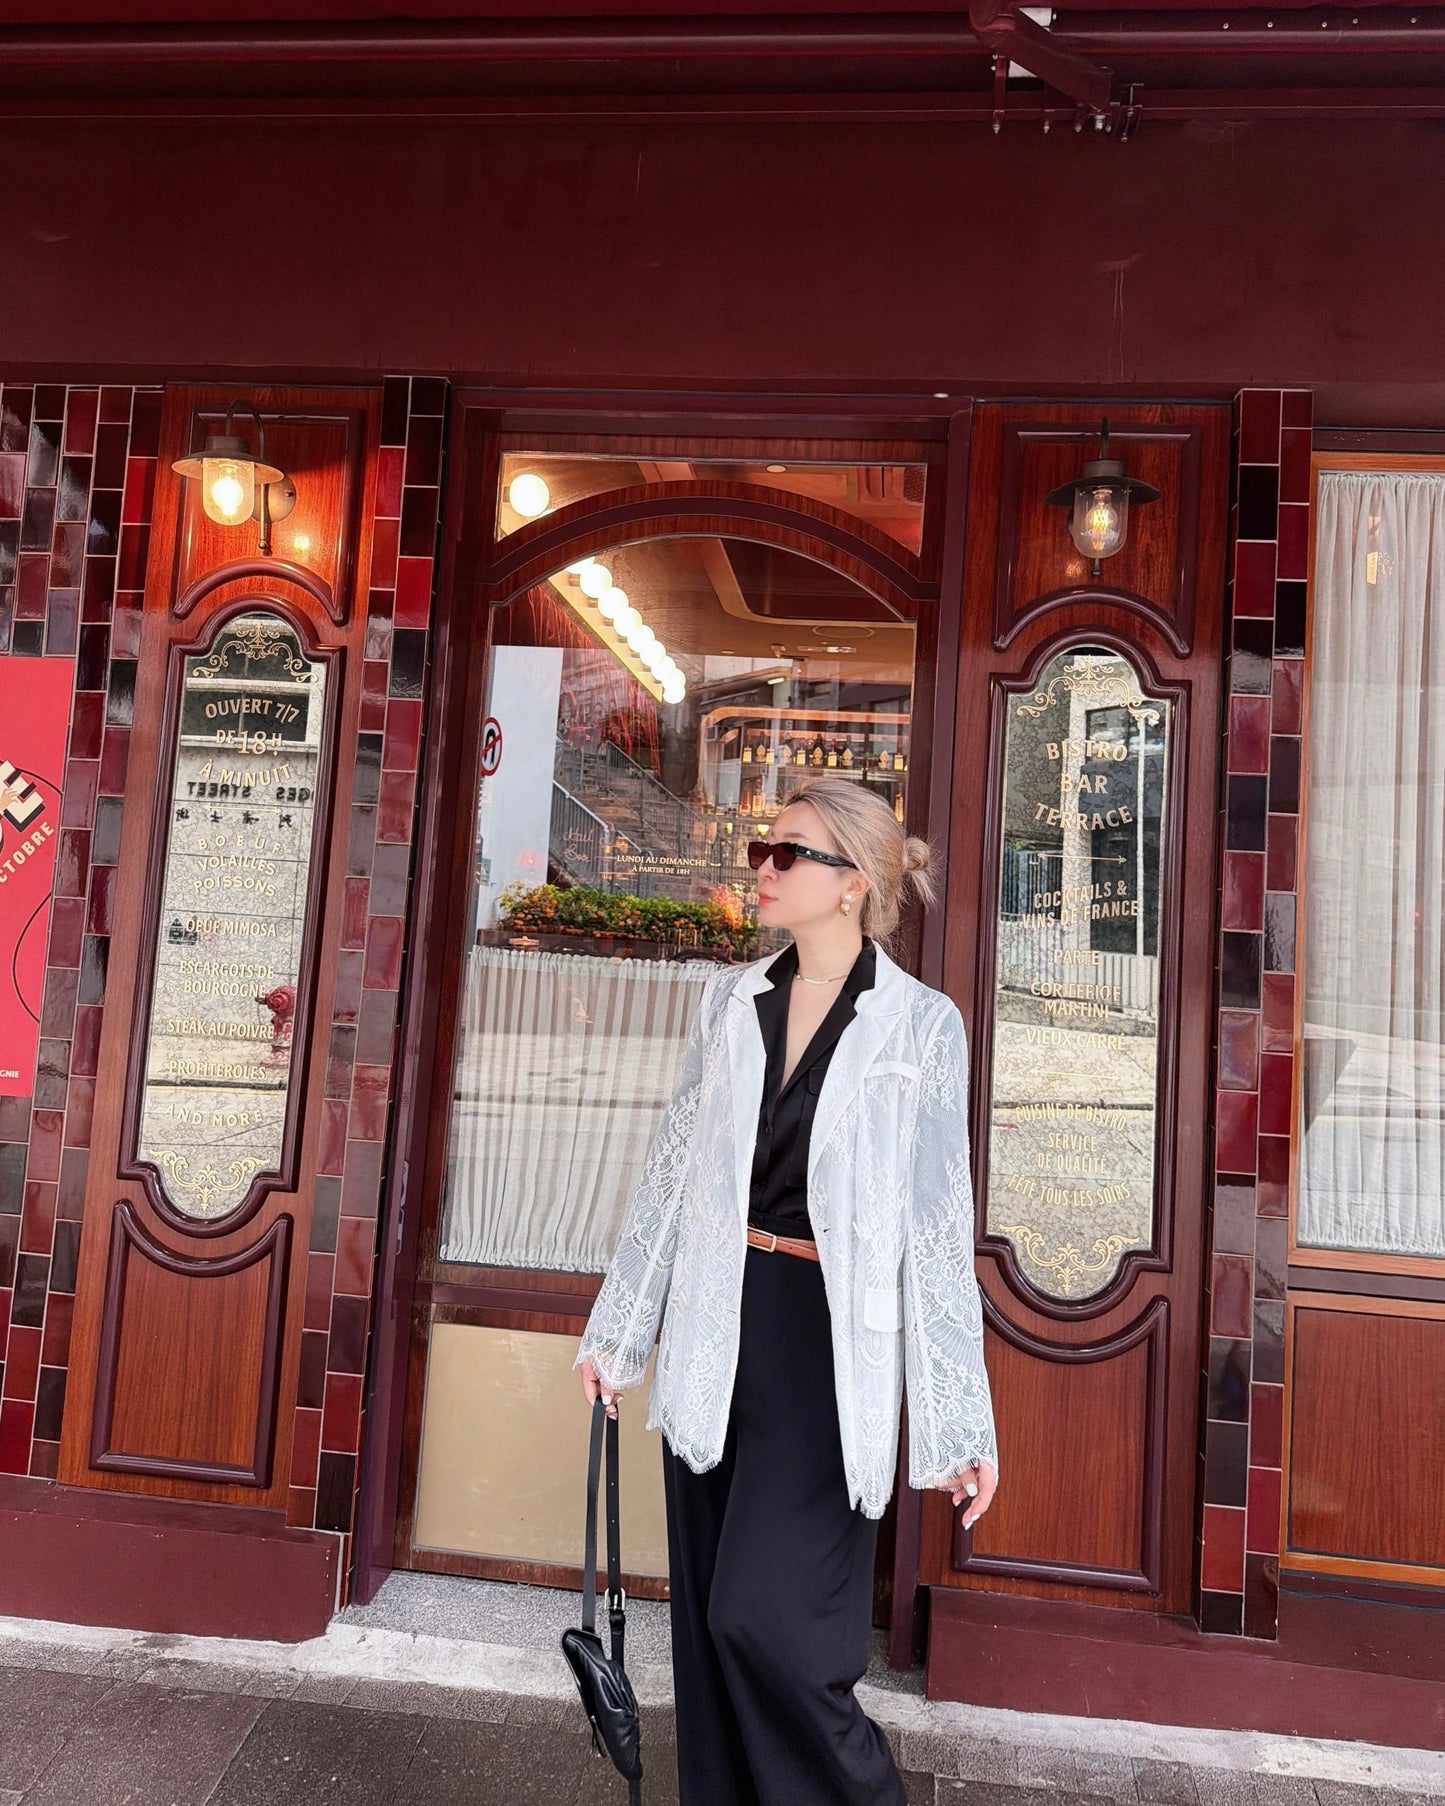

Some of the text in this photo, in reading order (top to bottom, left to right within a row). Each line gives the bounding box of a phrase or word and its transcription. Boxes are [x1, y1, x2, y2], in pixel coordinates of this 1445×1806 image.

[205, 698, 300, 724] OUVERT 7/7
[216, 729, 236, 744] DE
[1045, 740, 1128, 762] BISTRO
[199, 758, 291, 787] À MINUIT
[1060, 773, 1109, 794] BAR
[1034, 802, 1134, 831] TERRACE
[197, 835, 281, 854] BOEUF
[197, 855, 276, 876] VOLAILLES
[616, 854, 707, 867] LUNDI AU DIMANCHE
[665, 867, 676, 875] DE
[193, 876, 276, 896] POISSONS
[1033, 880, 1128, 909] COCKTAILS &
[1022, 900, 1139, 929] VINS DE FRANCE
[223, 921, 277, 937] MIMOSA
[179, 960, 275, 979] ESCARGOTS DE
[184, 980, 266, 998] BOURGOGNE
[1044, 1000, 1109, 1019] MARTINI
[168, 1019, 275, 1040] STEAK AU POIVRE
[1026, 1029, 1126, 1051] VIEUX CARRÉ
[169, 1060, 267, 1079] PROFITEROLES
[164, 1104, 263, 1127] AND MORE
[1015, 1102, 1127, 1131] CUISINE DE BISTRO
[1048, 1132, 1096, 1152] SERVICE
[1036, 1152, 1051, 1169] DE
[1008, 1174, 1130, 1207] FÊTE TOUS LES SOIRS
